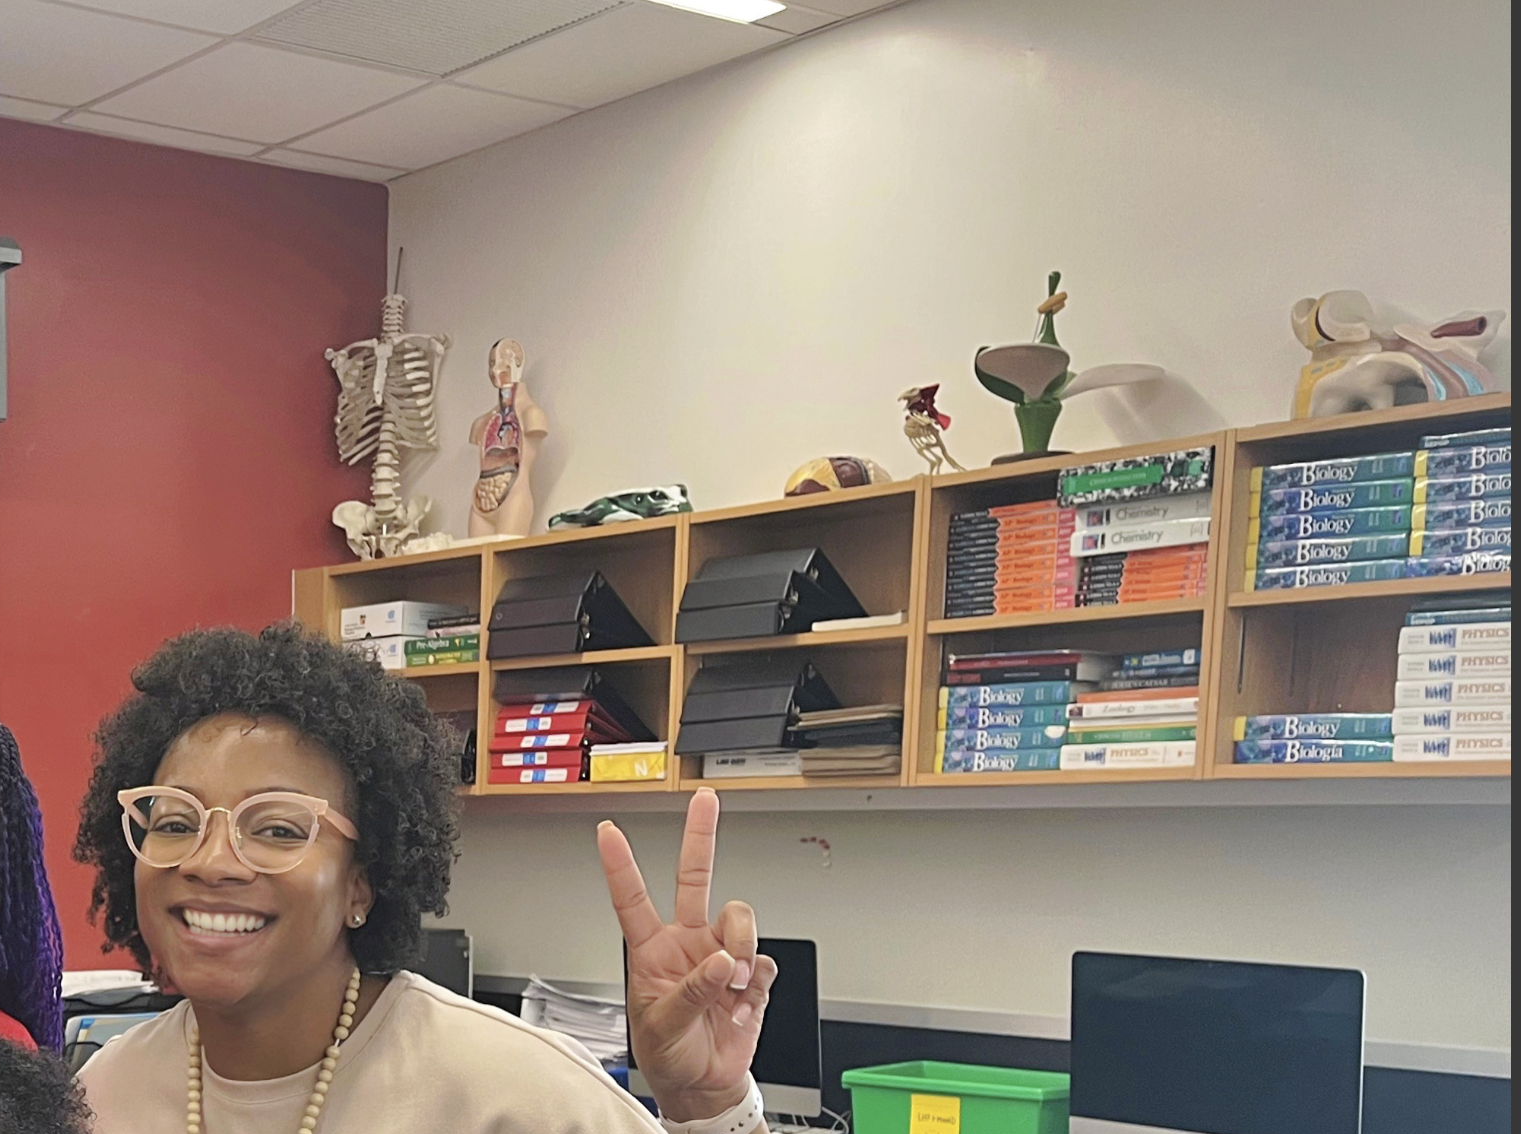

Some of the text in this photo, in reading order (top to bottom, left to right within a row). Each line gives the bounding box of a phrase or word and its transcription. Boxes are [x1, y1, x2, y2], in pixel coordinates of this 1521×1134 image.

[1469, 446, 1511, 470] Biolo
[1300, 463, 1358, 486] Biology
[1468, 473, 1511, 497] Biolo
[1298, 489, 1355, 512] Biology
[1115, 504, 1169, 521] Chemistry
[1468, 500, 1511, 523] Biolo
[1297, 514, 1355, 538] Biology
[1110, 529, 1164, 547] Chemistry
[1464, 527, 1511, 550] Biolog
[1295, 540, 1353, 565] Biology
[1460, 552, 1511, 576] Biolog
[1294, 566, 1351, 588] Biology
[1461, 628, 1509, 639] PHYSICS
[1460, 655, 1509, 667] PHYSICS
[979, 686, 1024, 707] Biology
[1457, 682, 1506, 694] PHYSICS
[977, 707, 1023, 728] Biology
[1455, 711, 1504, 722] PHYSICS
[1283, 716, 1341, 739] Biology
[975, 730, 1021, 750] Biology
[1454, 738, 1504, 749] PHYSICS
[972, 751, 1019, 772] Biology
[1109, 747, 1149, 758] PHYSICS
[633, 759, 649, 778] N
